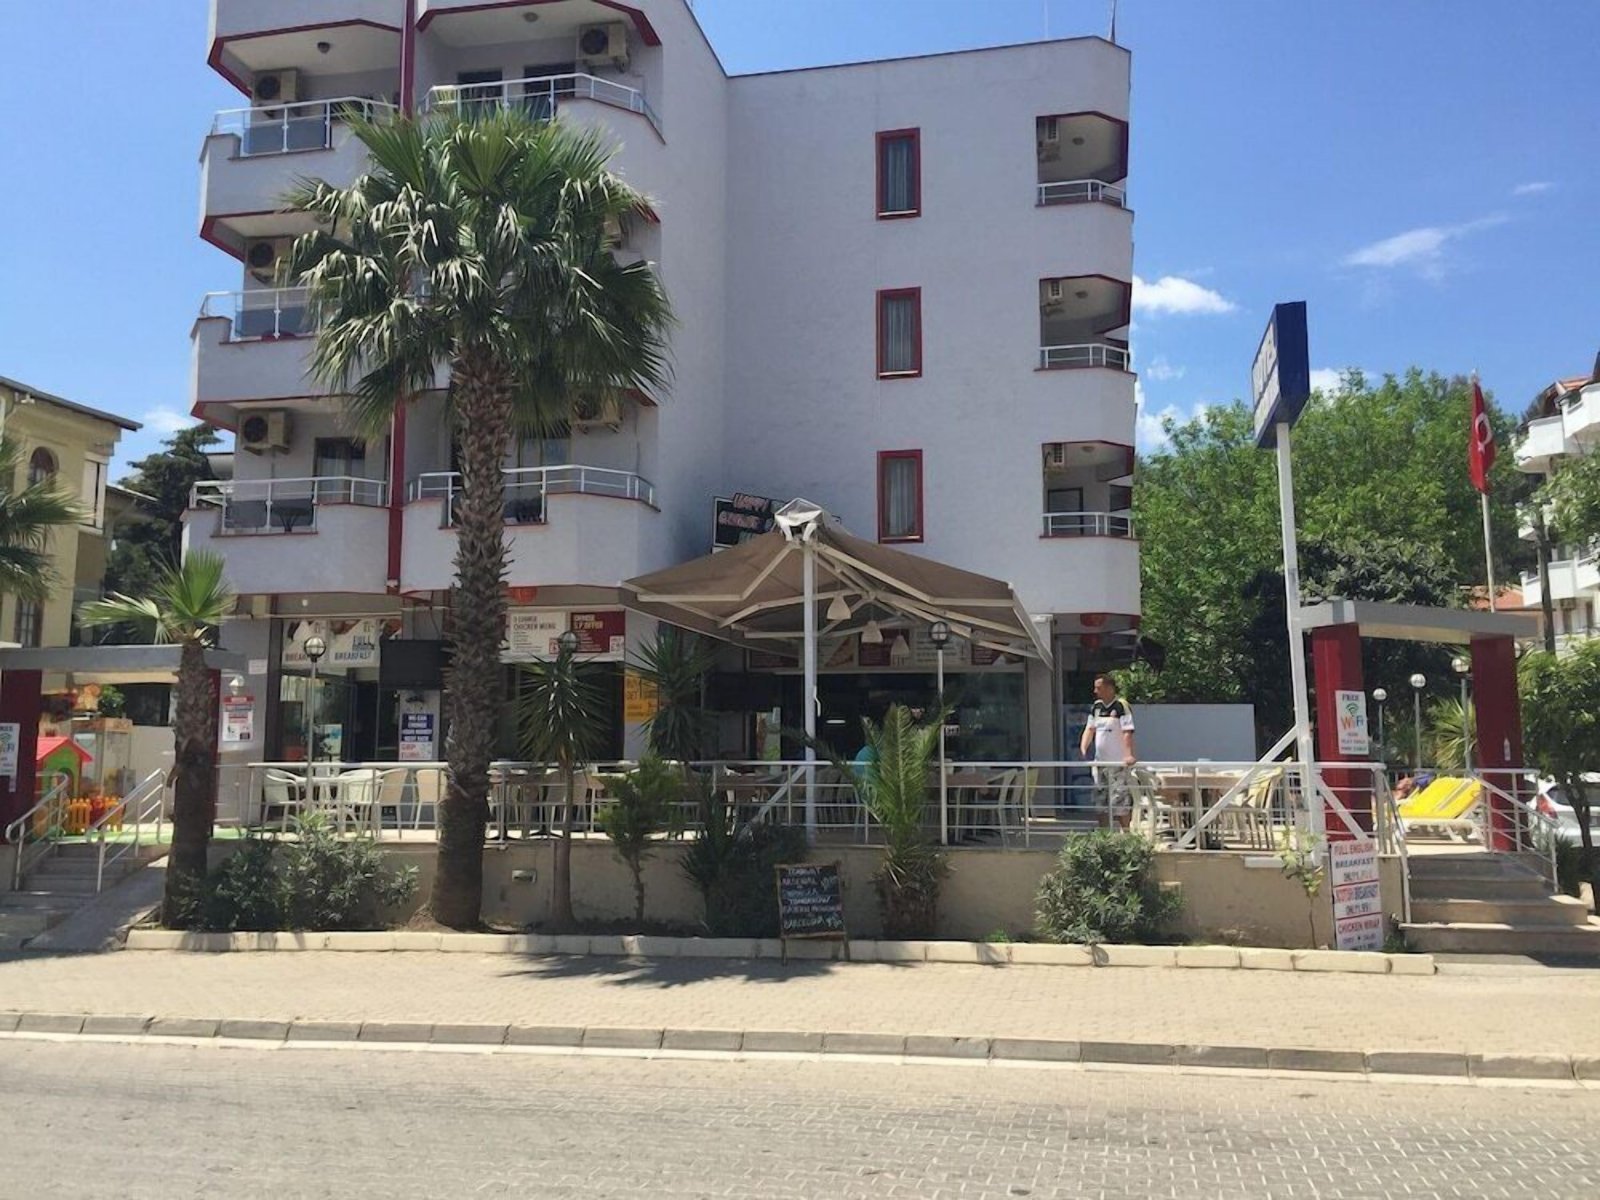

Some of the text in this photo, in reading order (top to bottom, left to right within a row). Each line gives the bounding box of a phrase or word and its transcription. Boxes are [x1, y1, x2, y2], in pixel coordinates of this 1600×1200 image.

[1342, 693, 1359, 701] FREE
[1335, 857, 1374, 869] BREAKFAST
[1338, 921, 1363, 935] CHICKEN
